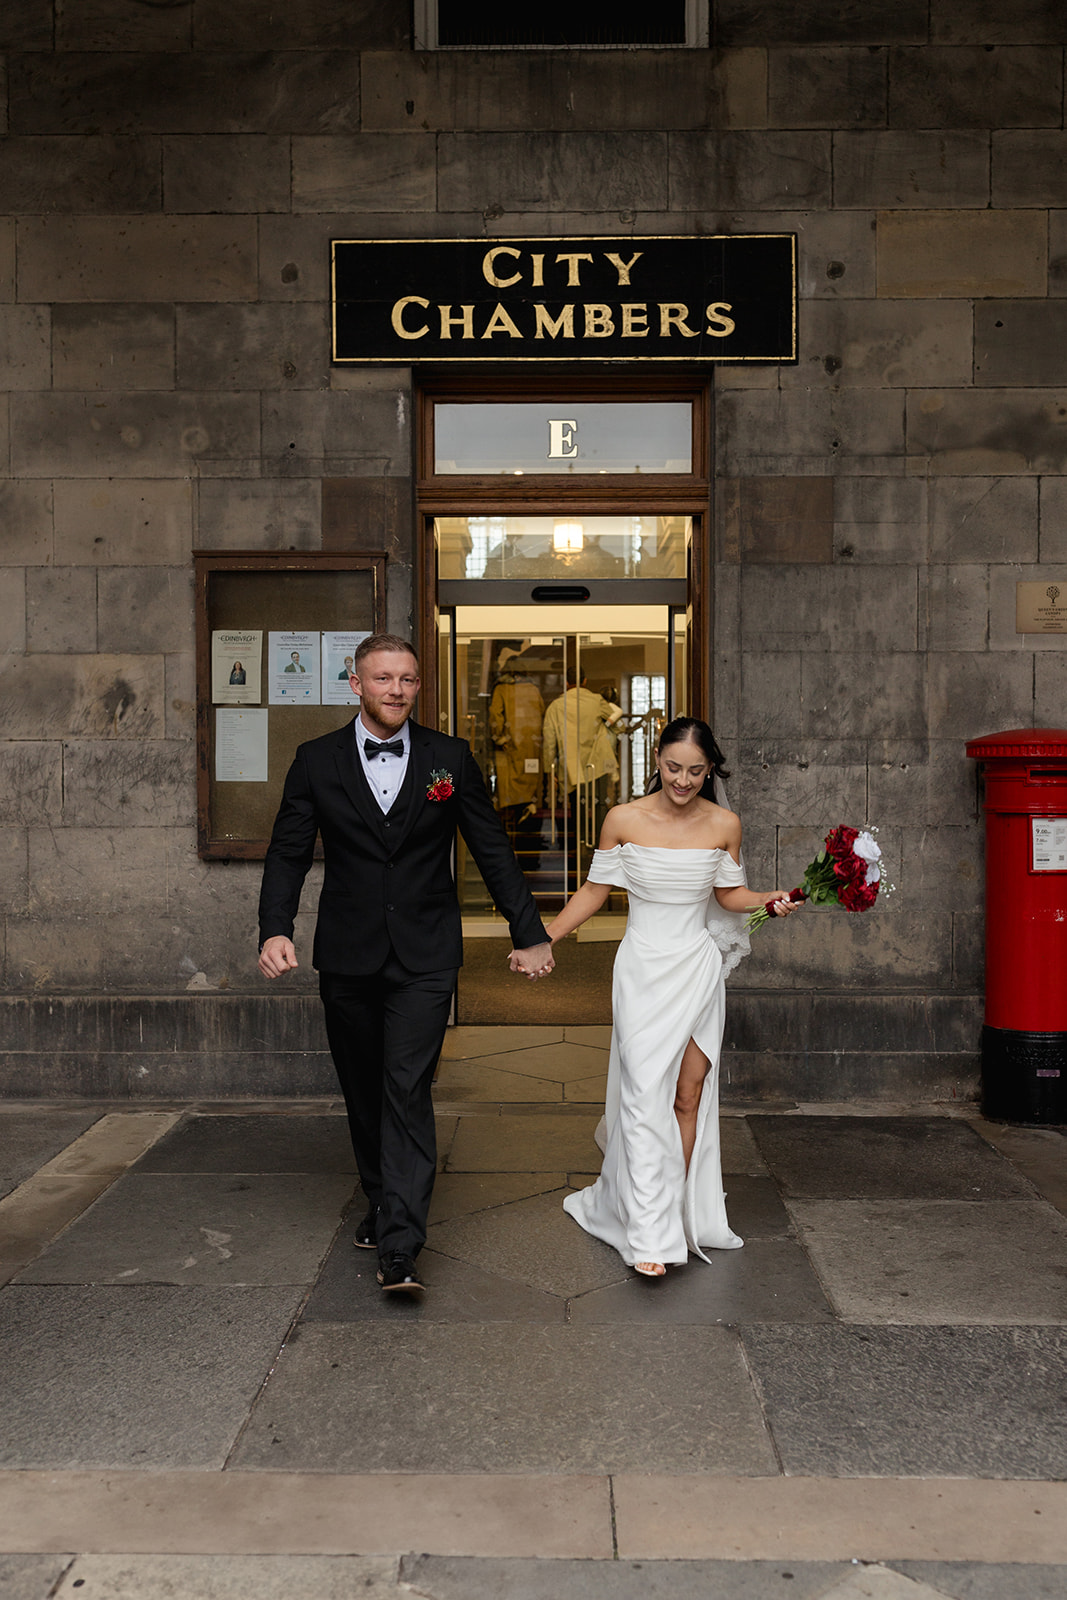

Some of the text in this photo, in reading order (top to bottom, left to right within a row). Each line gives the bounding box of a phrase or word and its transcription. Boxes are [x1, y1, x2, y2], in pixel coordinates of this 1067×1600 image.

[482, 246, 644, 288] CITY
[391, 296, 736, 340] CHAMBERS
[547, 419, 578, 459] E
